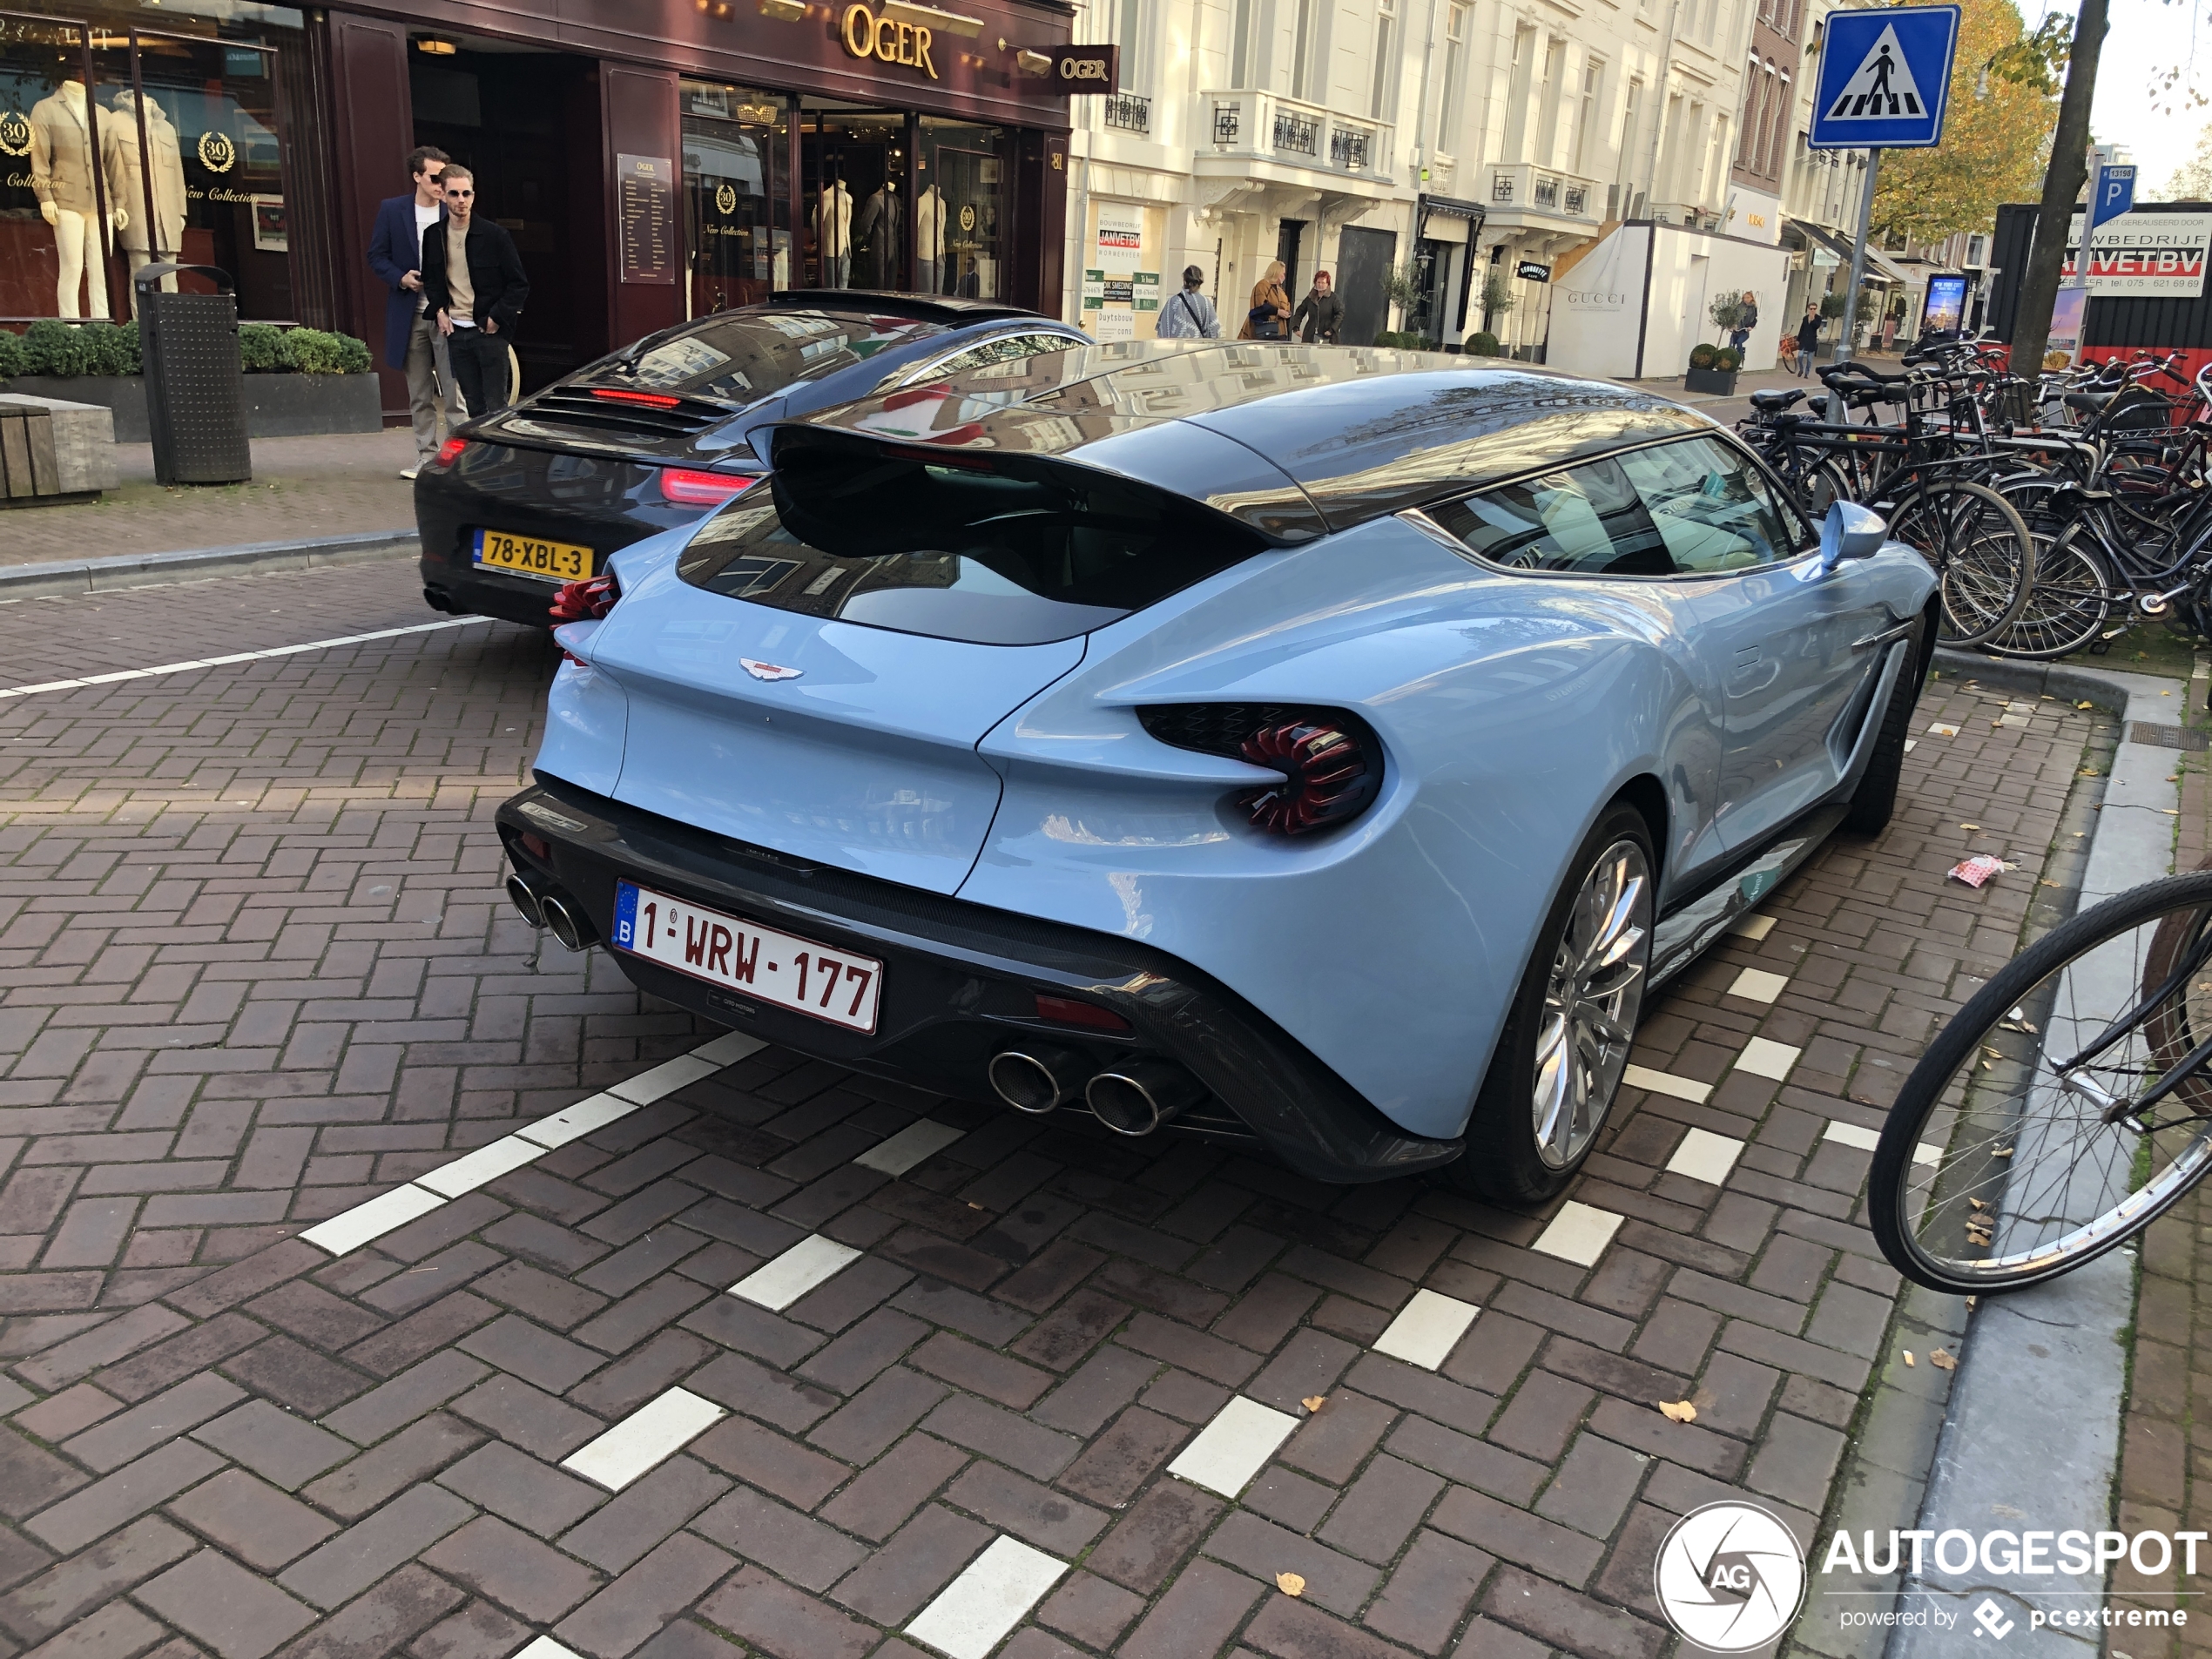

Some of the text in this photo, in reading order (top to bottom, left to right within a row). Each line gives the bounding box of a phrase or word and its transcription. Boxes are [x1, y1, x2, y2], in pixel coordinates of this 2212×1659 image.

[842, 3, 939, 80] OGER
[1060, 57, 1109, 82] OGER
[3, 122, 26, 139] 30
[206, 140, 226, 157] 30
[637, 162, 654, 172] OGER
[2111, 169, 2132, 178] 13198
[7, 172, 66, 190] Collection
[208, 187, 260, 204] Collection
[719, 191, 732, 203] 30
[2106, 183, 2122, 206] P
[962, 212, 973, 221] 30
[1099, 219, 1142, 230] BOUWBEDRIJF
[720, 225, 749, 237] Collection
[2069, 235, 2207, 245] UWBEDRIJF
[1098, 249, 1140, 259] WORMERVEER
[2111, 279, 2124, 287] tel.
[2127, 279, 2144, 287] 075
[1568, 293, 1625, 305] GUCCI
[1099, 313, 1133, 322] Duytsbouw
[490, 536, 582, 576] 78-XBL-3
[619, 920, 631, 942] B
